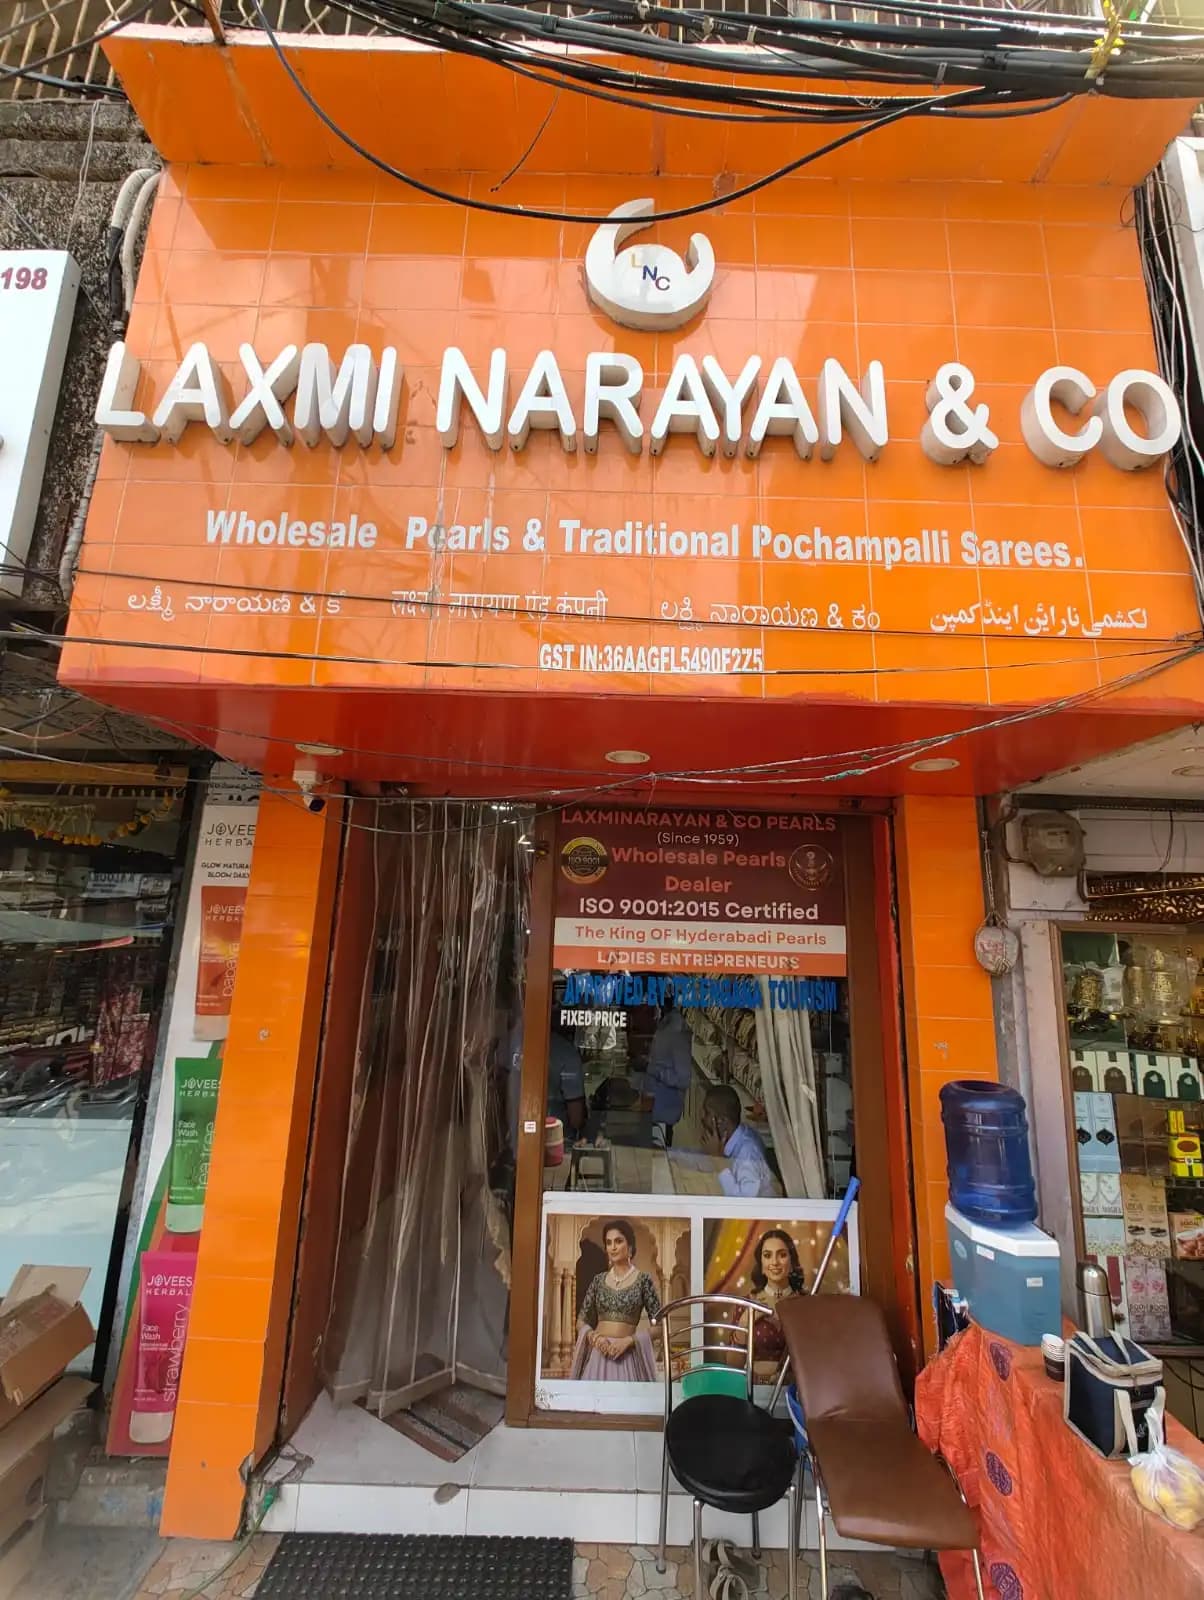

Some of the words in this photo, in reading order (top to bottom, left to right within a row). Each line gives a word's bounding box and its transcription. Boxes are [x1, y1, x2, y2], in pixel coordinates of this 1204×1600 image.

[0, 267, 48, 290] 198
[94, 341, 398, 434] LAXMI
[436, 346, 889, 447] NARAYAN
[930, 362, 999, 450] &
[1033, 365, 1182, 455] CO
[205, 510, 378, 549] Wholesale
[404, 516, 511, 551] Pearls
[522, 518, 545, 552] &
[559, 519, 740, 557] Traditional
[751, 525, 950, 570] Pochampalli
[960, 530, 1084, 568] Sarees.
[299, 594, 316, 614] &
[827, 602, 844, 628] &
[539, 643, 575, 672] GST
[206, 822, 257, 836] JOVEE
[561, 809, 711, 829] LAXMINARAYAN
[715, 813, 728, 828] &
[734, 814, 761, 830] CO
[767, 815, 837, 832] PEARLS
[205, 838, 253, 847] HERBA
[656, 831, 701, 846] (Since
[703, 833, 740, 848] 1959)
[222, 862, 250, 870] NATURA
[611, 847, 719, 865] Wholesale
[723, 851, 786, 869] Pearls
[664, 875, 733, 894] Dealer
[207, 903, 244, 915] JOVEE
[579, 898, 615, 915] ISO
[619, 899, 720, 917] 9001:2015
[725, 902, 819, 920] Certified
[575, 925, 605, 939] The
[609, 927, 646, 944] King
[650, 928, 672, 941] OF
[676, 929, 772, 945] Hyderabadi
[776, 932, 827, 946] Pearls
[597, 950, 656, 966] LADIES
[660, 952, 801, 970] ENTREPRENEURS
[563, 974, 644, 1007] APPROVED
[647, 975, 668, 1008] BY
[768, 979, 837, 1011] TOURISM
[560, 1009, 592, 1027] FIXED
[595, 1010, 627, 1028] PRICE
[147, 1274, 193, 1288] JOVEES
[145, 1289, 192, 1297] HERBAL
[163, 1302, 190, 1402] strawberry
